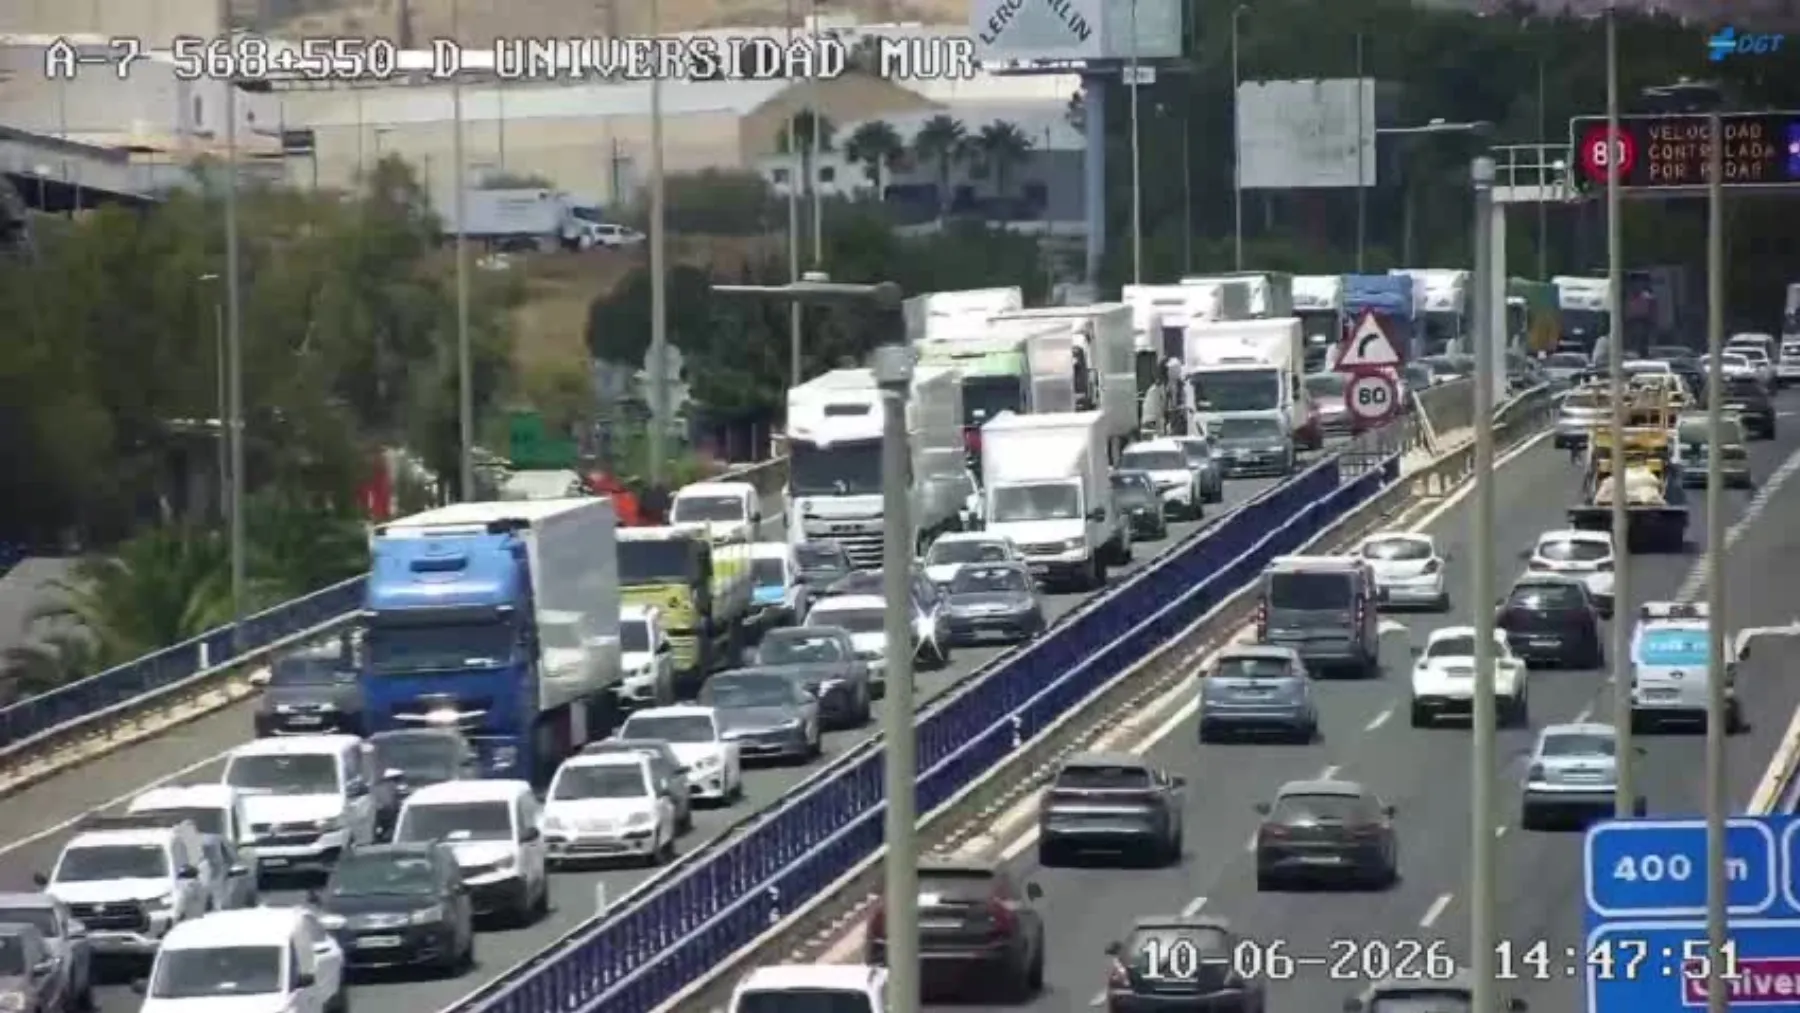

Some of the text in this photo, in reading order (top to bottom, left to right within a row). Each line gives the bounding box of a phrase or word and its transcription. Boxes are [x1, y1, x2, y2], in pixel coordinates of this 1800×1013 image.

[1649, 124, 1763, 140] VELOCDAD
[1648, 143, 1776, 161] CONTRLADA
[1360, 387, 1386, 405] 80
[1613, 854, 1692, 881] 400
